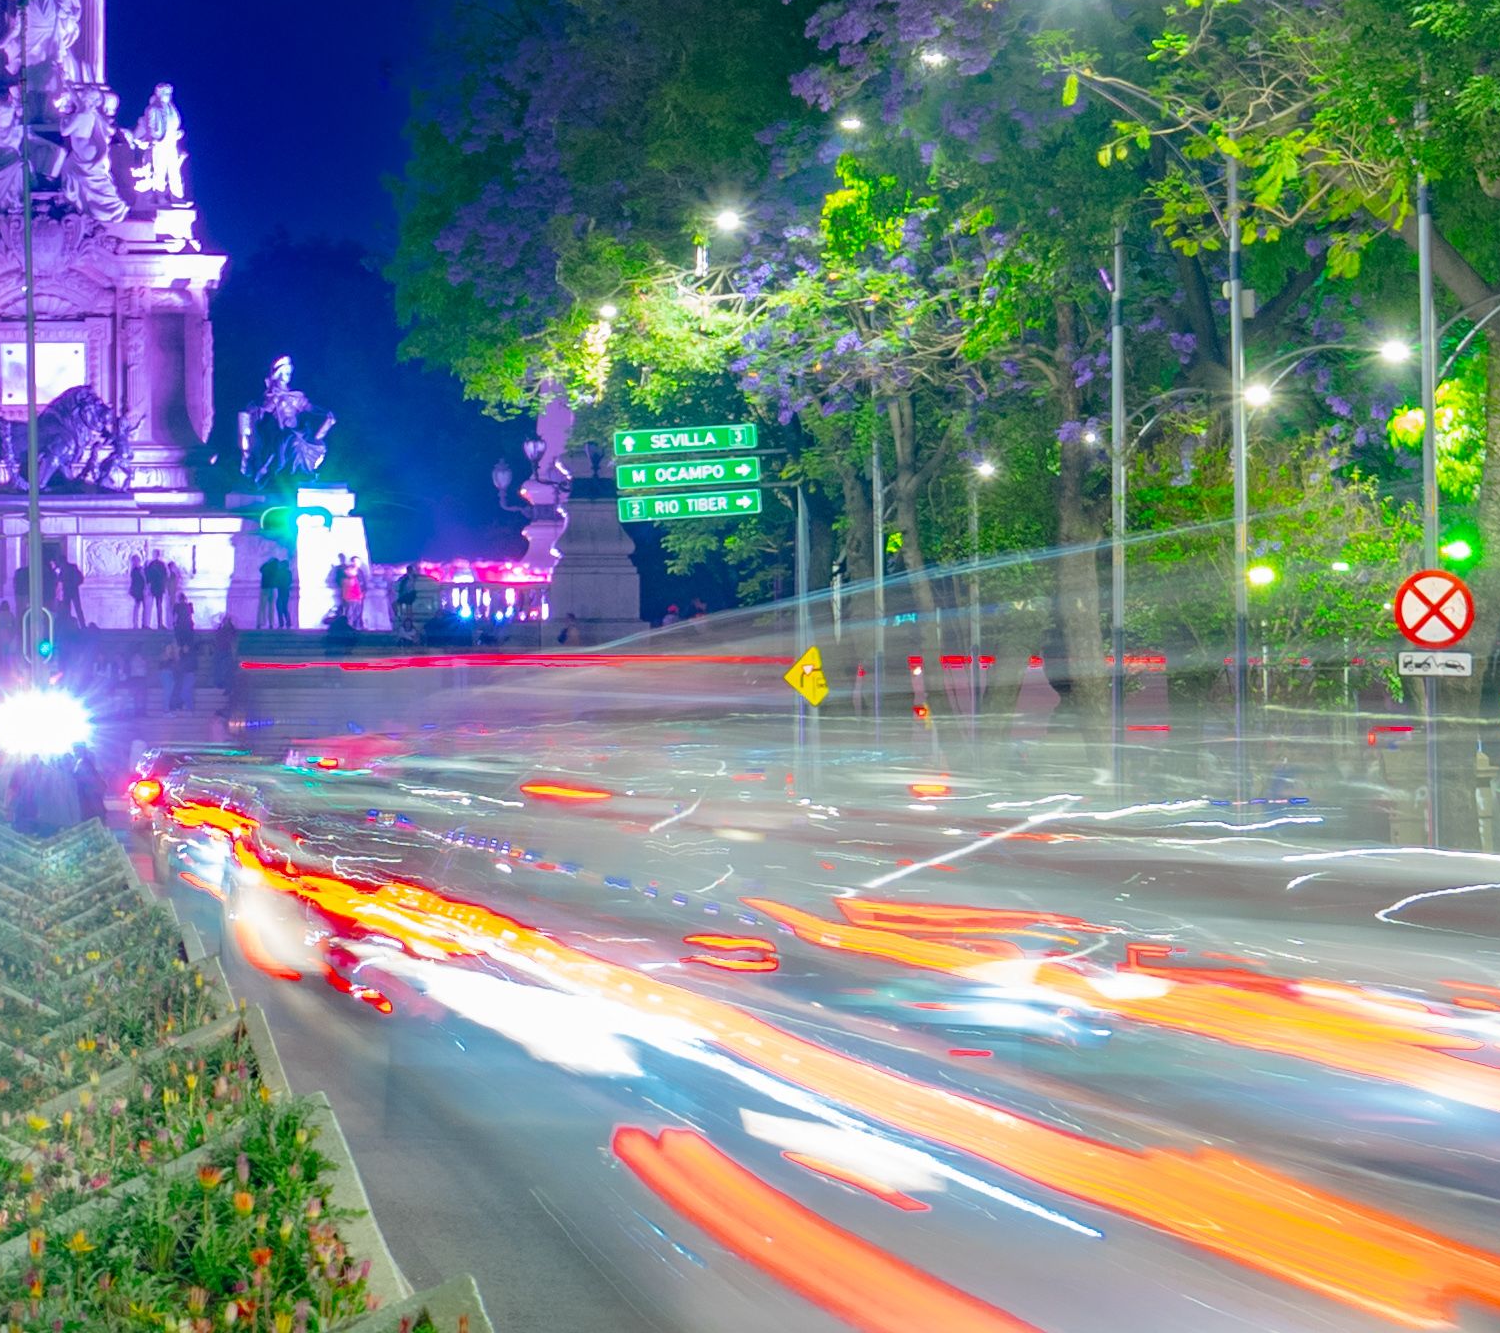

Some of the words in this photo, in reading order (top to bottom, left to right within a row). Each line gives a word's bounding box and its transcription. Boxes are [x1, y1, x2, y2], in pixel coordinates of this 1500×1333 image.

[650, 431, 717, 449] SEVILLA
[734, 428, 743, 443] 3
[631, 469, 646, 484] M
[654, 464, 725, 482] OCAMPO
[631, 503, 641, 515] 2
[654, 499, 680, 515] RIO
[686, 496, 728, 513] TIBER
